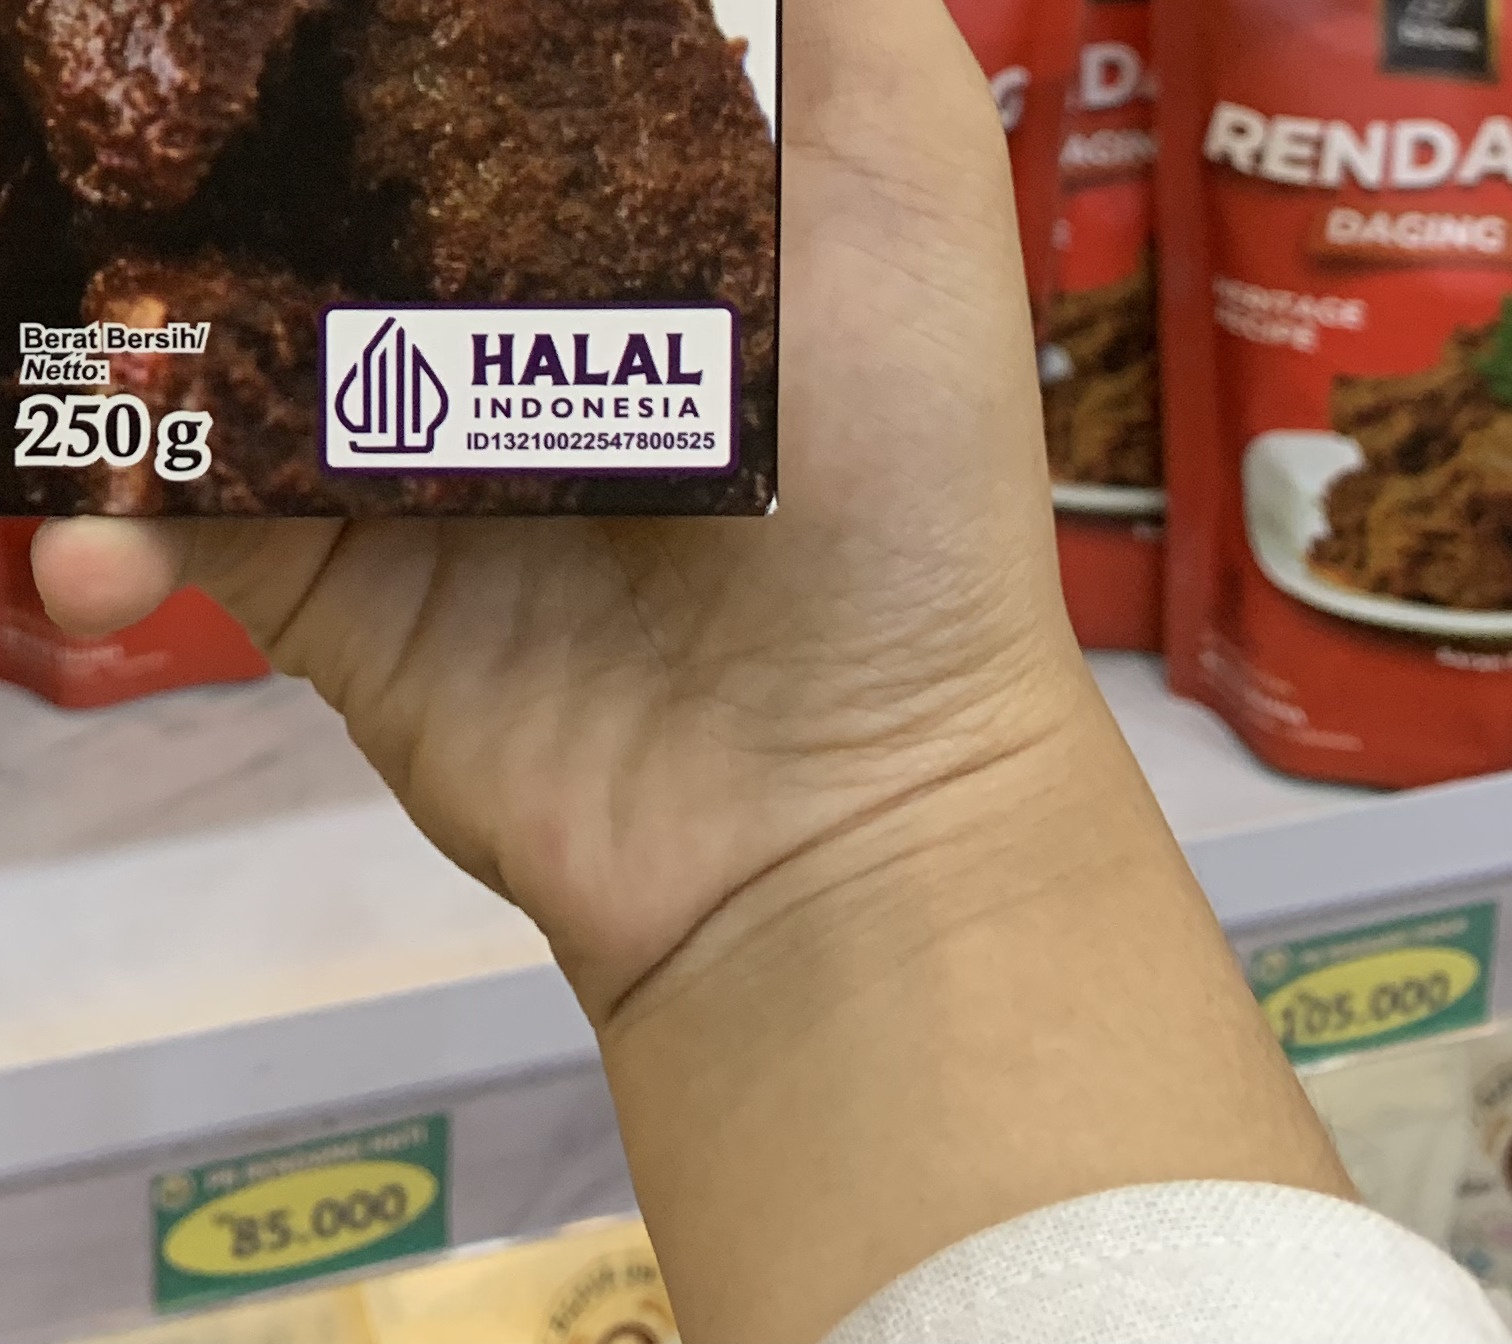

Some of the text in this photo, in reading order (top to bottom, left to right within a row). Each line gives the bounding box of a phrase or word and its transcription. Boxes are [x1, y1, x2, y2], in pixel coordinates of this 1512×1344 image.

[23, 326, 207, 349] Berat Bersih/
[24, 357, 107, 381] Netto:
[472, 333, 703, 386] HALAL
[474, 397, 700, 418] INDONESIA
[23, 401, 205, 473] 250 g
[466, 431, 716, 451] ID13210022547800525
[230, 1183, 409, 1258] 85.000
